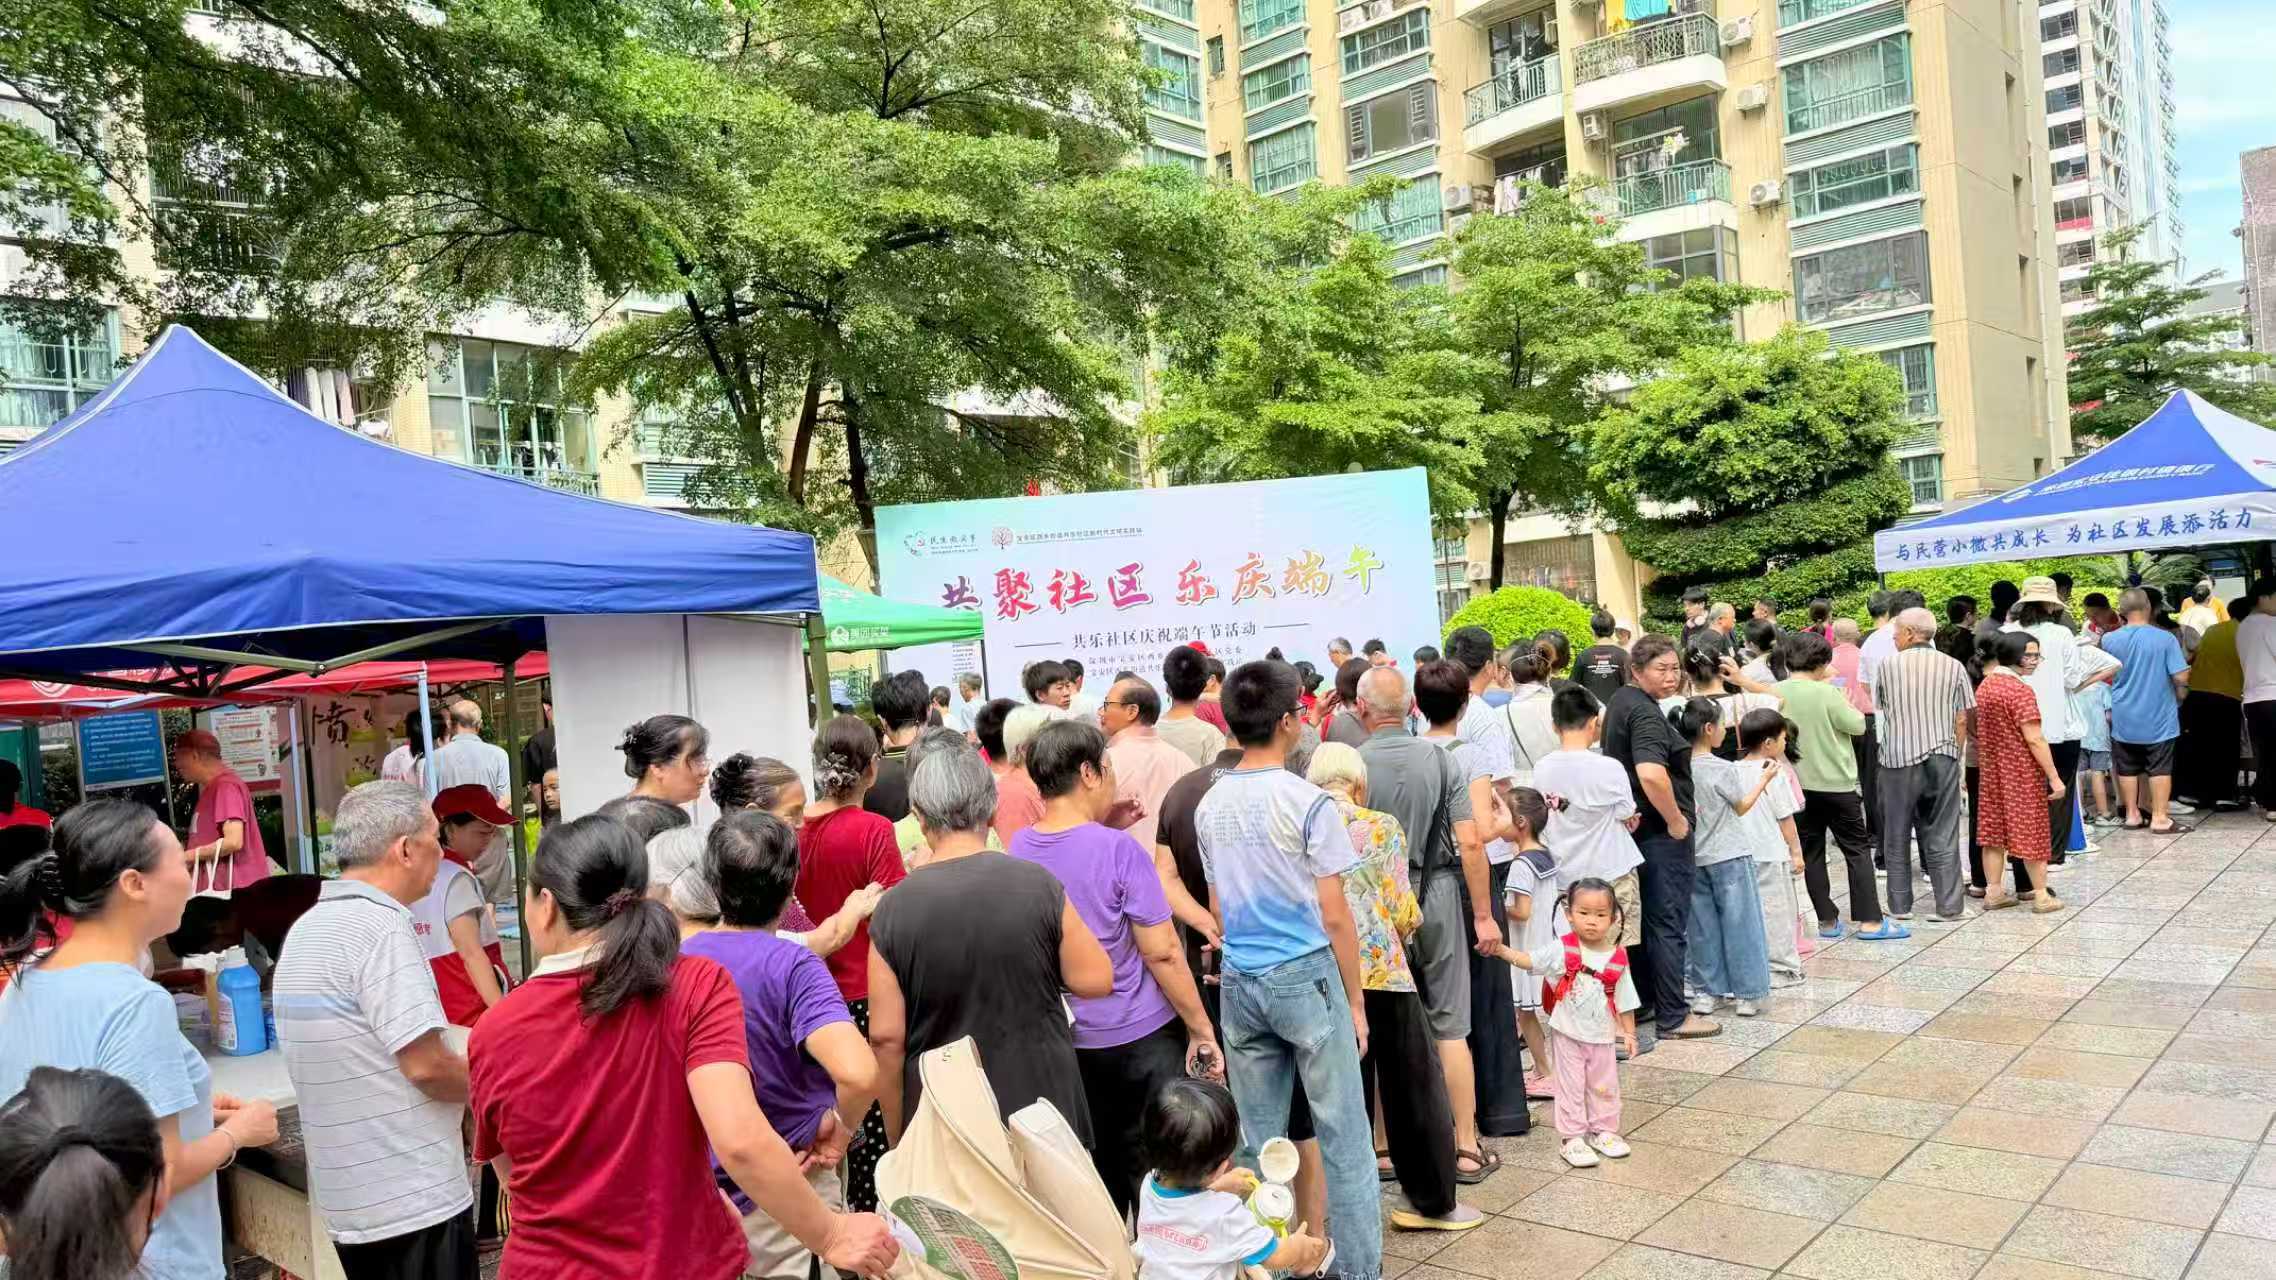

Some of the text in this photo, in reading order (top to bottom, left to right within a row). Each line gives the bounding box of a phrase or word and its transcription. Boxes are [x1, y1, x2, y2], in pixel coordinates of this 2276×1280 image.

[1895, 508, 2252, 561] 与民营小微共成长 为社区发展添活力
[942, 545, 1384, 620] 共聚社区 乐庆端午
[1072, 621, 1257, 649] 共乐社区庆祝端午节活动
